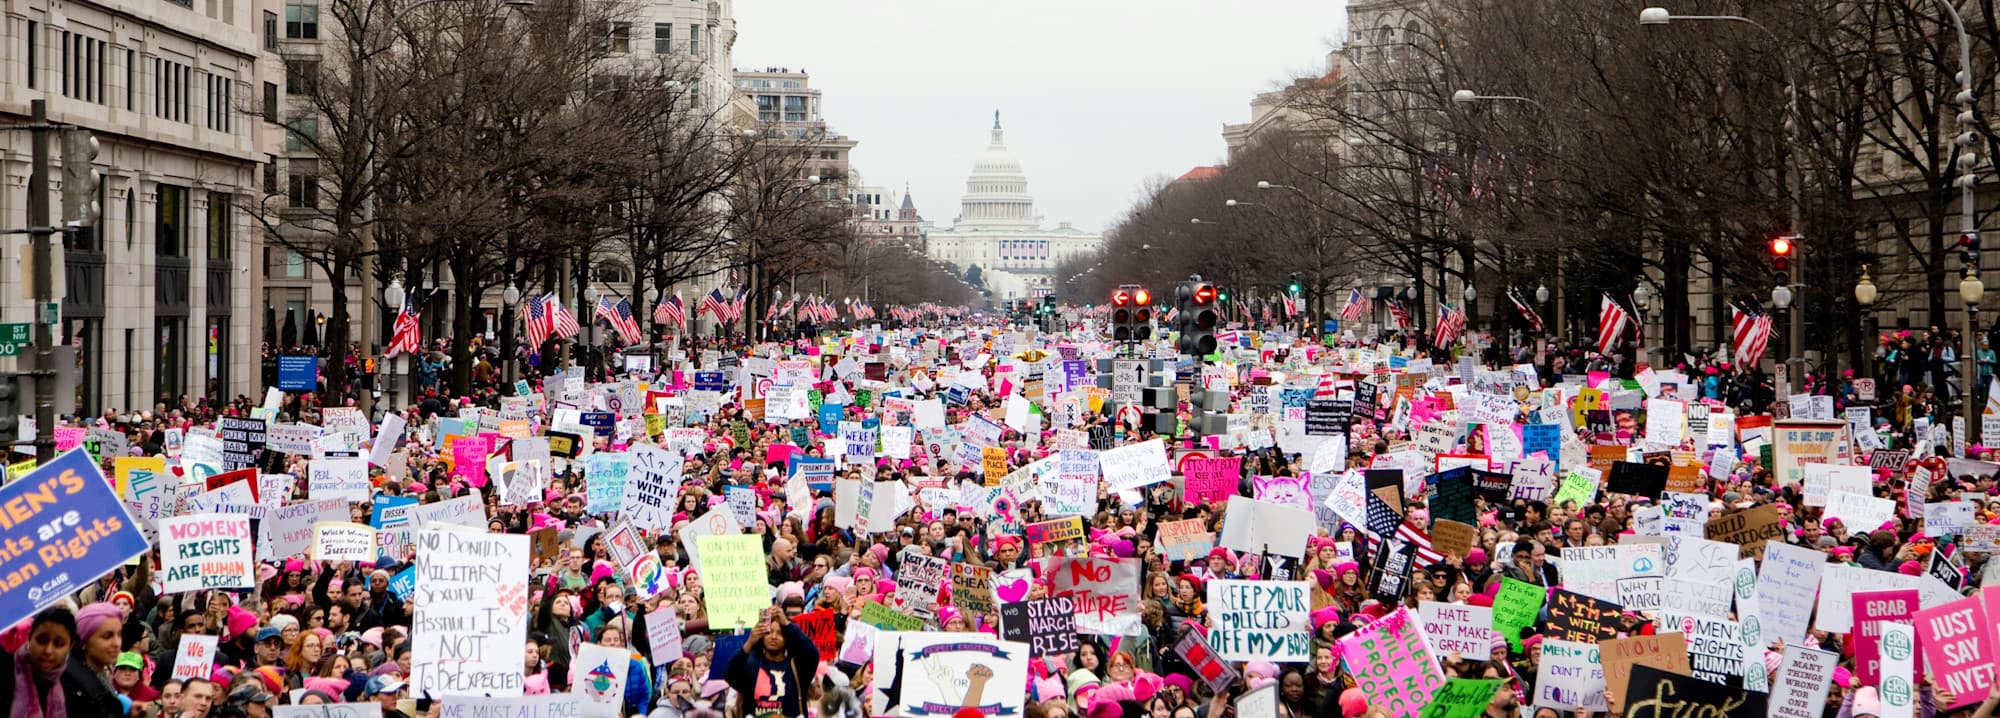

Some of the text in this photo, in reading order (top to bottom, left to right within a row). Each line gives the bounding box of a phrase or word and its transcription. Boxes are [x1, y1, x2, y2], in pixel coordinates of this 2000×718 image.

[13, 325, 24, 333] ST
[1115, 384, 1132, 392] OBEY
[324, 409, 354, 417] NASTY
[1546, 411, 1563, 421] YES
[1688, 404, 1709, 419] NO!
[223, 419, 265, 430] NOBODY
[325, 419, 356, 428] WOMEN
[55, 429, 76, 438] SHE
[223, 431, 266, 442] PUTS MY
[223, 443, 248, 451] BABY
[223, 453, 254, 463] MAKER
[1220, 458, 1239, 469] BODY
[223, 462, 234, 470] IN
[645, 470, 663, 485] I'M
[1480, 480, 1508, 490] MARCH
[637, 479, 667, 499] WITH
[149, 495, 159, 520] FOR
[638, 494, 661, 508] HER
[37, 510, 81, 541] are
[1706, 514, 1746, 538] BUILD
[375, 532, 412, 546] EQUAL
[1049, 528, 1081, 539] STAND
[38, 515, 123, 568] Rights
[418, 532, 440, 551] NO
[178, 539, 240, 560] RIGHTS
[1562, 547, 1616, 562] RACISM
[904, 551, 922, 567] KEEP
[167, 562, 245, 581] ARE HUMAN
[417, 553, 502, 584] MILITARY
[1070, 559, 1112, 587] NO
[42, 572, 69, 592] CAIR
[201, 575, 242, 588] RIGHTS
[392, 575, 412, 593] WE
[898, 578, 913, 589] OUT
[1382, 572, 1401, 585] NO
[1620, 581, 1648, 592] WHY
[1220, 584, 1307, 612] KEEP YOUR
[1027, 597, 1073, 617] STAND
[1437, 607, 1471, 622] HATE
[1573, 602, 1600, 621] I'M
[1866, 600, 1907, 618] GRAB
[1029, 615, 1076, 636] MARCH
[1221, 609, 1290, 631] POLICIES
[1568, 615, 1601, 634] WITH
[1929, 608, 1976, 642] JUST
[1457, 627, 1491, 641] MAKE
[188, 641, 204, 657] We
[439, 635, 488, 662] NOT
[1032, 632, 1080, 654] RISE
[1210, 629, 1285, 657] OFF MY
[1438, 638, 1483, 655] GREAT!
[1543, 644, 1571, 657] MEN
[1615, 640, 1659, 658] NOW
[1693, 637, 1744, 661] RIGHTS
[1800, 651, 1819, 662] TOO
[1943, 637, 1981, 667] SAY
[176, 661, 208, 678] won't
[1693, 654, 1744, 678] HUMAN
[1792, 660, 1824, 673] MANY
[953, 678, 969, 688] OR
[1787, 668, 1823, 683] THINGS
[1945, 662, 1995, 696] NYET
[1785, 678, 1820, 692] WRONG
[1789, 688, 1809, 700] FOR
[442, 704, 464, 718] WE
[518, 703, 538, 718] ALL
[1787, 698, 1809, 710] ONE
